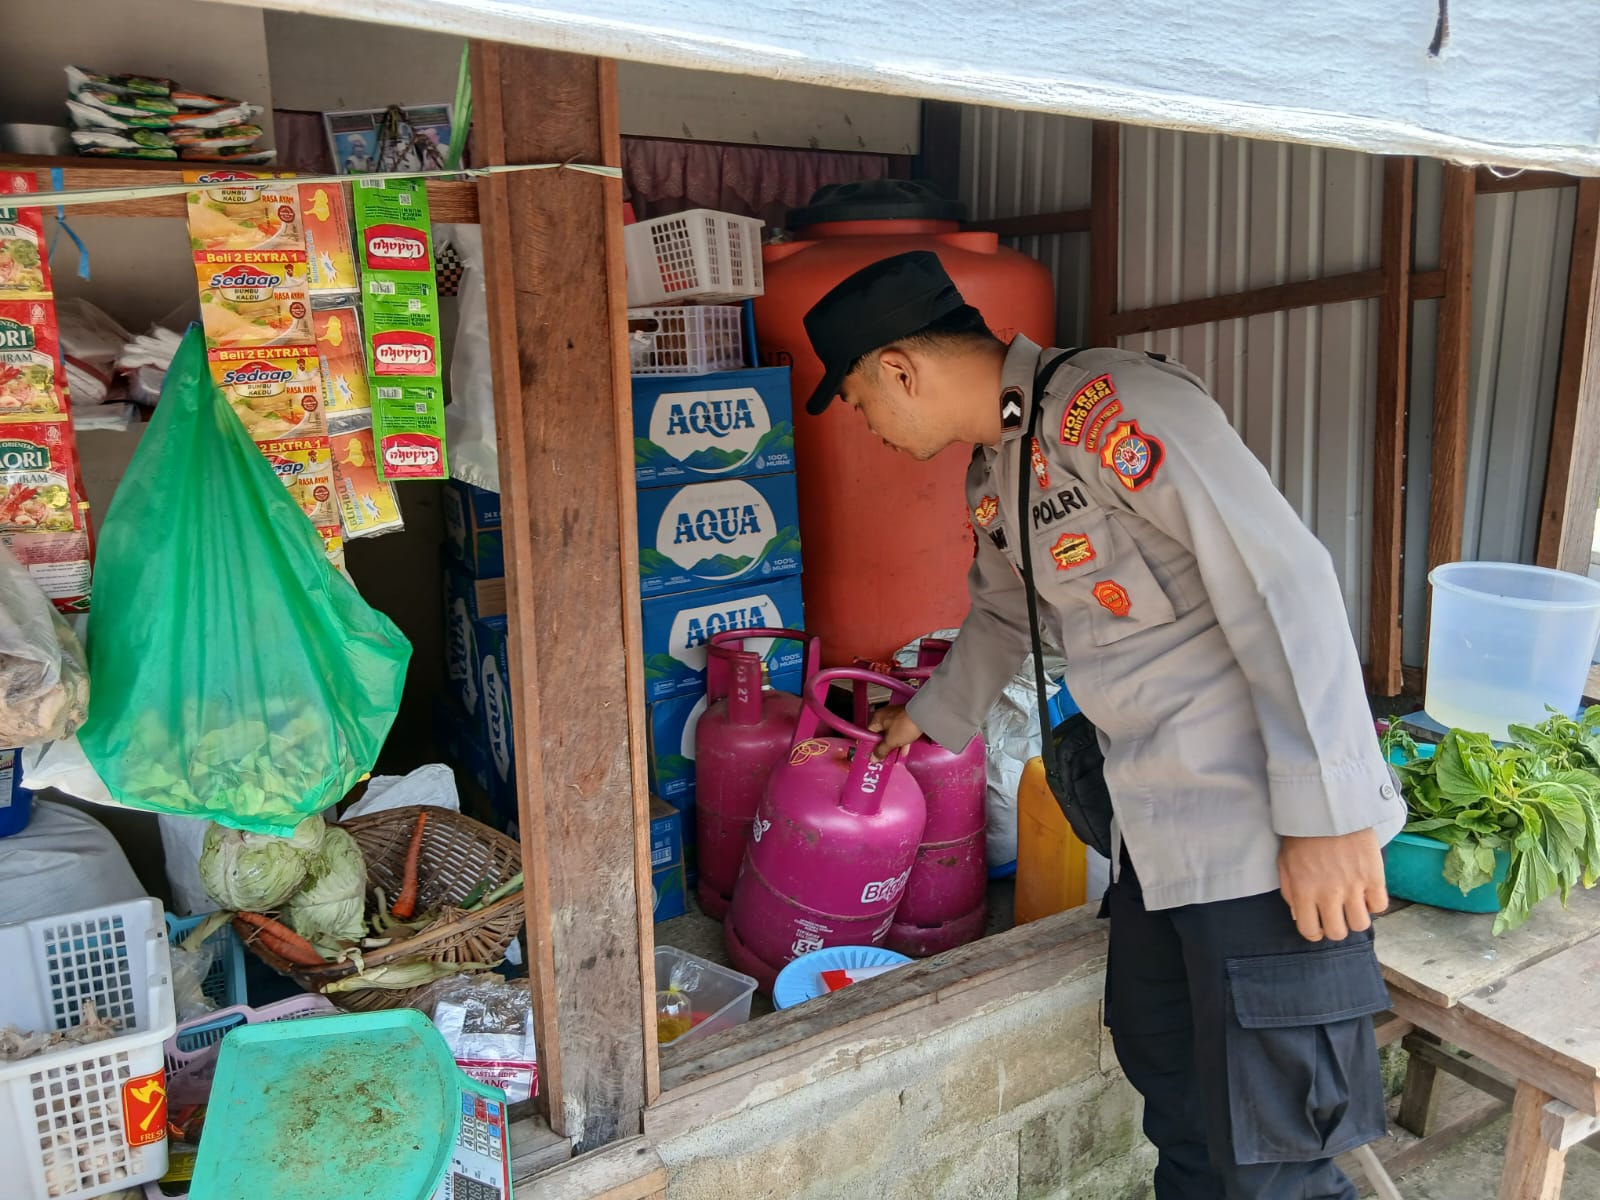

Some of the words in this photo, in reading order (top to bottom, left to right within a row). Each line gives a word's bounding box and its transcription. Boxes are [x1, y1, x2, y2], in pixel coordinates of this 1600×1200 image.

[262, 195, 277, 203] RASA
[279, 195, 295, 203] AYAM
[373, 239, 422, 256] Ladaku
[206, 253, 232, 263] Beli
[234, 254, 242, 263] 2
[244, 254, 289, 263] EXTRA
[291, 253, 298, 262] 1
[210, 273, 281, 288] Sedaap
[274, 292, 290, 301] RASA
[291, 292, 305, 300] AYAM
[220, 351, 244, 361] Beli
[247, 351, 255, 360] 2
[257, 348, 301, 359] EXTRA
[303, 348, 309, 356] 1
[380, 346, 428, 362] Ladaku
[223, 369, 293, 384] Sedaap
[286, 387, 300, 395] RASA
[303, 385, 317, 394] AYAM
[1086, 388, 1112, 411] UTARA
[1063, 380, 1107, 439] POLRES
[667, 399, 755, 438] AQUA
[260, 444, 267, 453] 2
[269, 440, 315, 452] EXTRA
[316, 439, 322, 449] 1
[389, 449, 436, 463] Ladaku
[273, 462, 305, 474] aap
[298, 478, 313, 486] RASA
[315, 476, 329, 484] AYAM
[1032, 486, 1089, 530] POLRI
[673, 504, 762, 544] AQUA
[737, 687, 748, 704] 27
